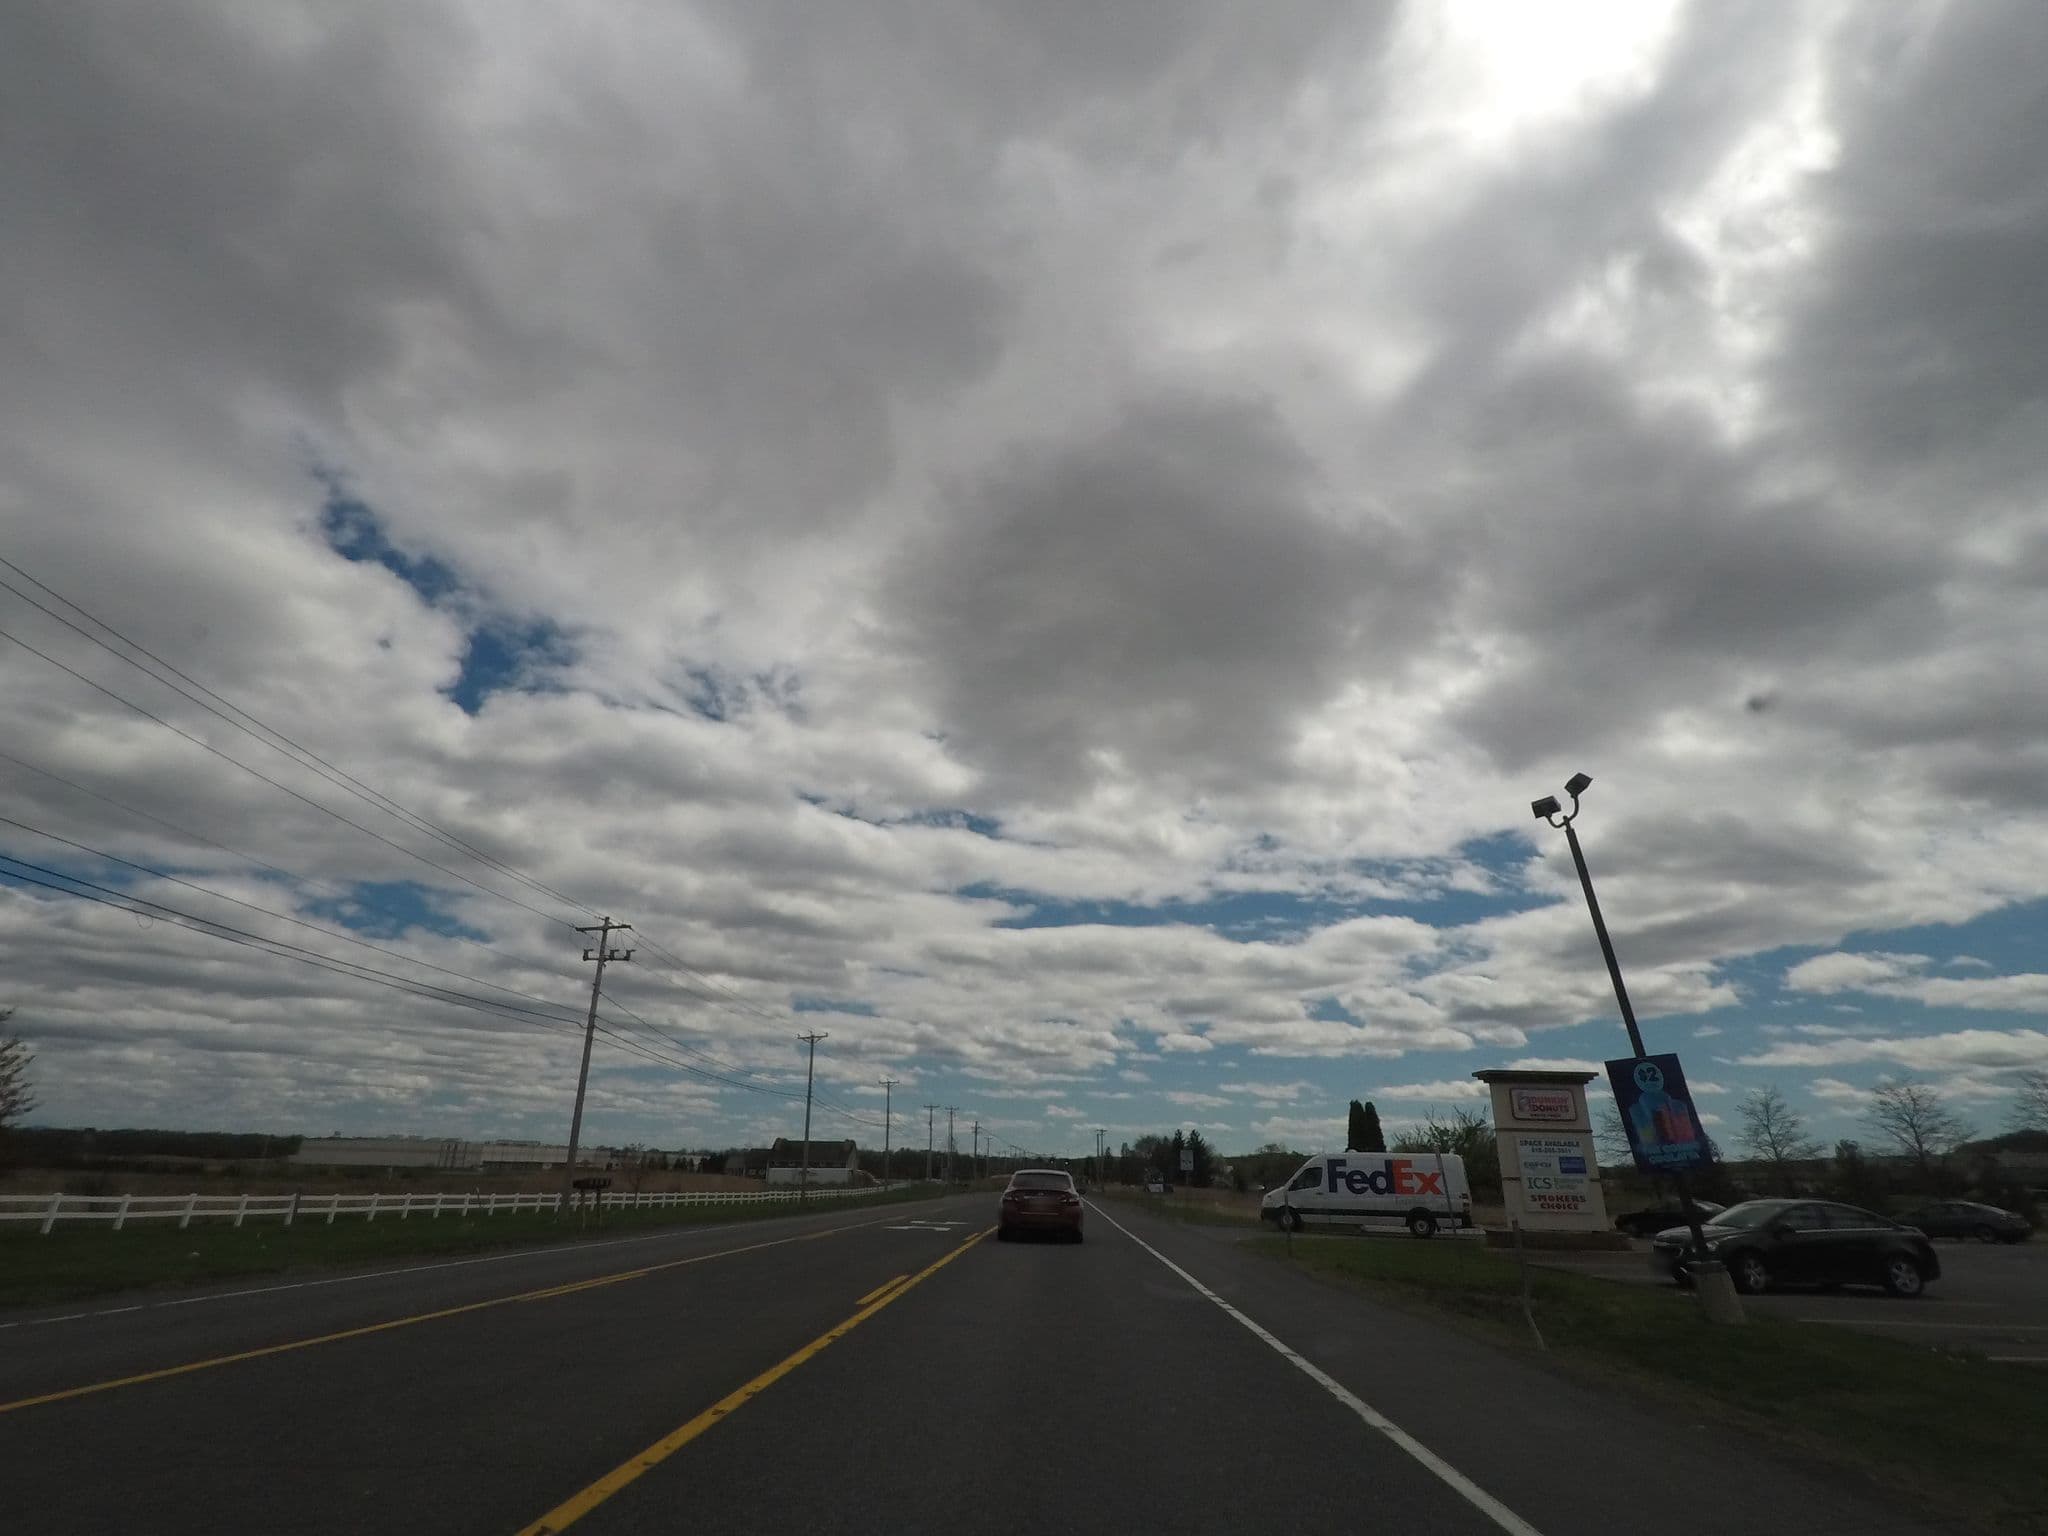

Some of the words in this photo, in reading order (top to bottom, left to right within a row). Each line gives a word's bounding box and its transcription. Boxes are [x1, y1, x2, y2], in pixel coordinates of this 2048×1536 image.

[1531, 1104, 1570, 1113] DONUTS
[1327, 1159, 1443, 1195] FedEx
[1528, 1177, 1552, 1189] ICS
[1530, 1194, 1586, 1203] SMOKERS
[1540, 1202, 1580, 1210] CHOICE
